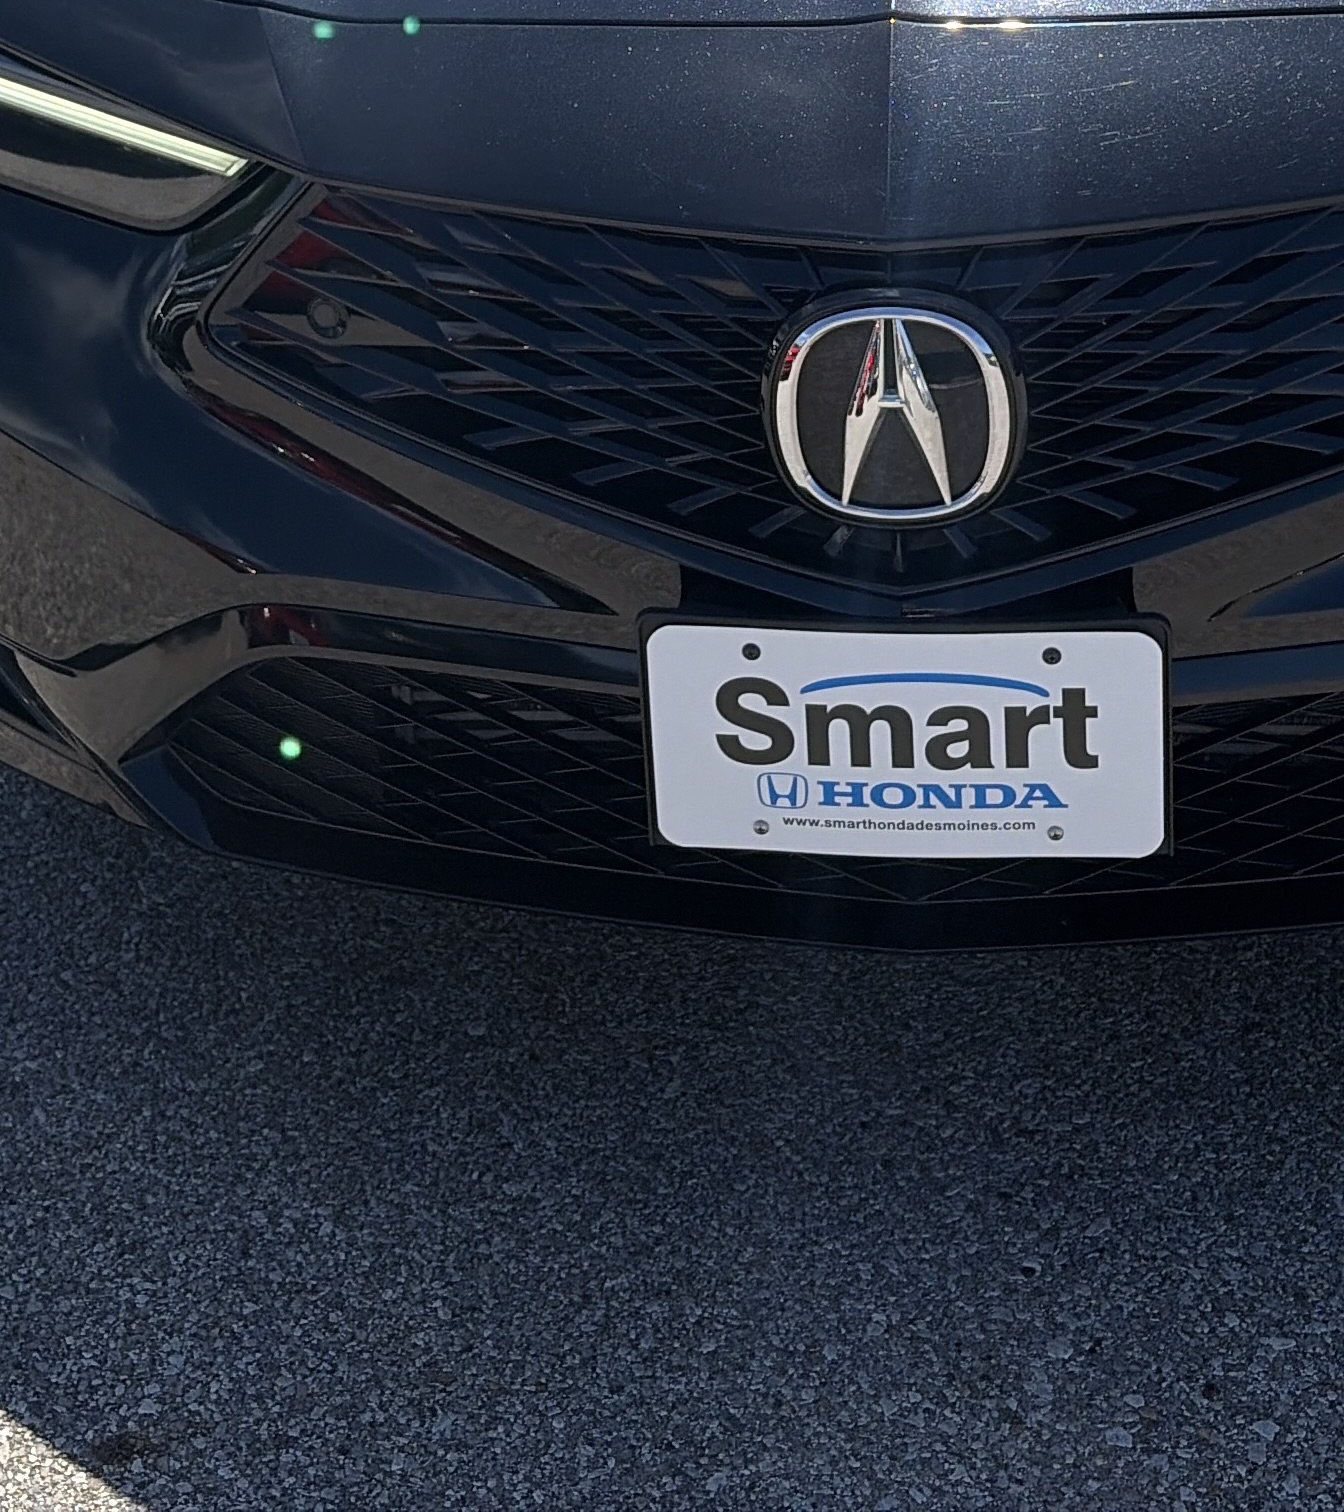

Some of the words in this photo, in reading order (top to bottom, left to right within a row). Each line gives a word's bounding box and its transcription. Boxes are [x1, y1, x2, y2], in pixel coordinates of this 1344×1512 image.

[715, 676, 1099, 769] Smart
[818, 782, 1068, 809] HONDA
[782, 817, 1036, 832] www.smarthondadesmoines.com
